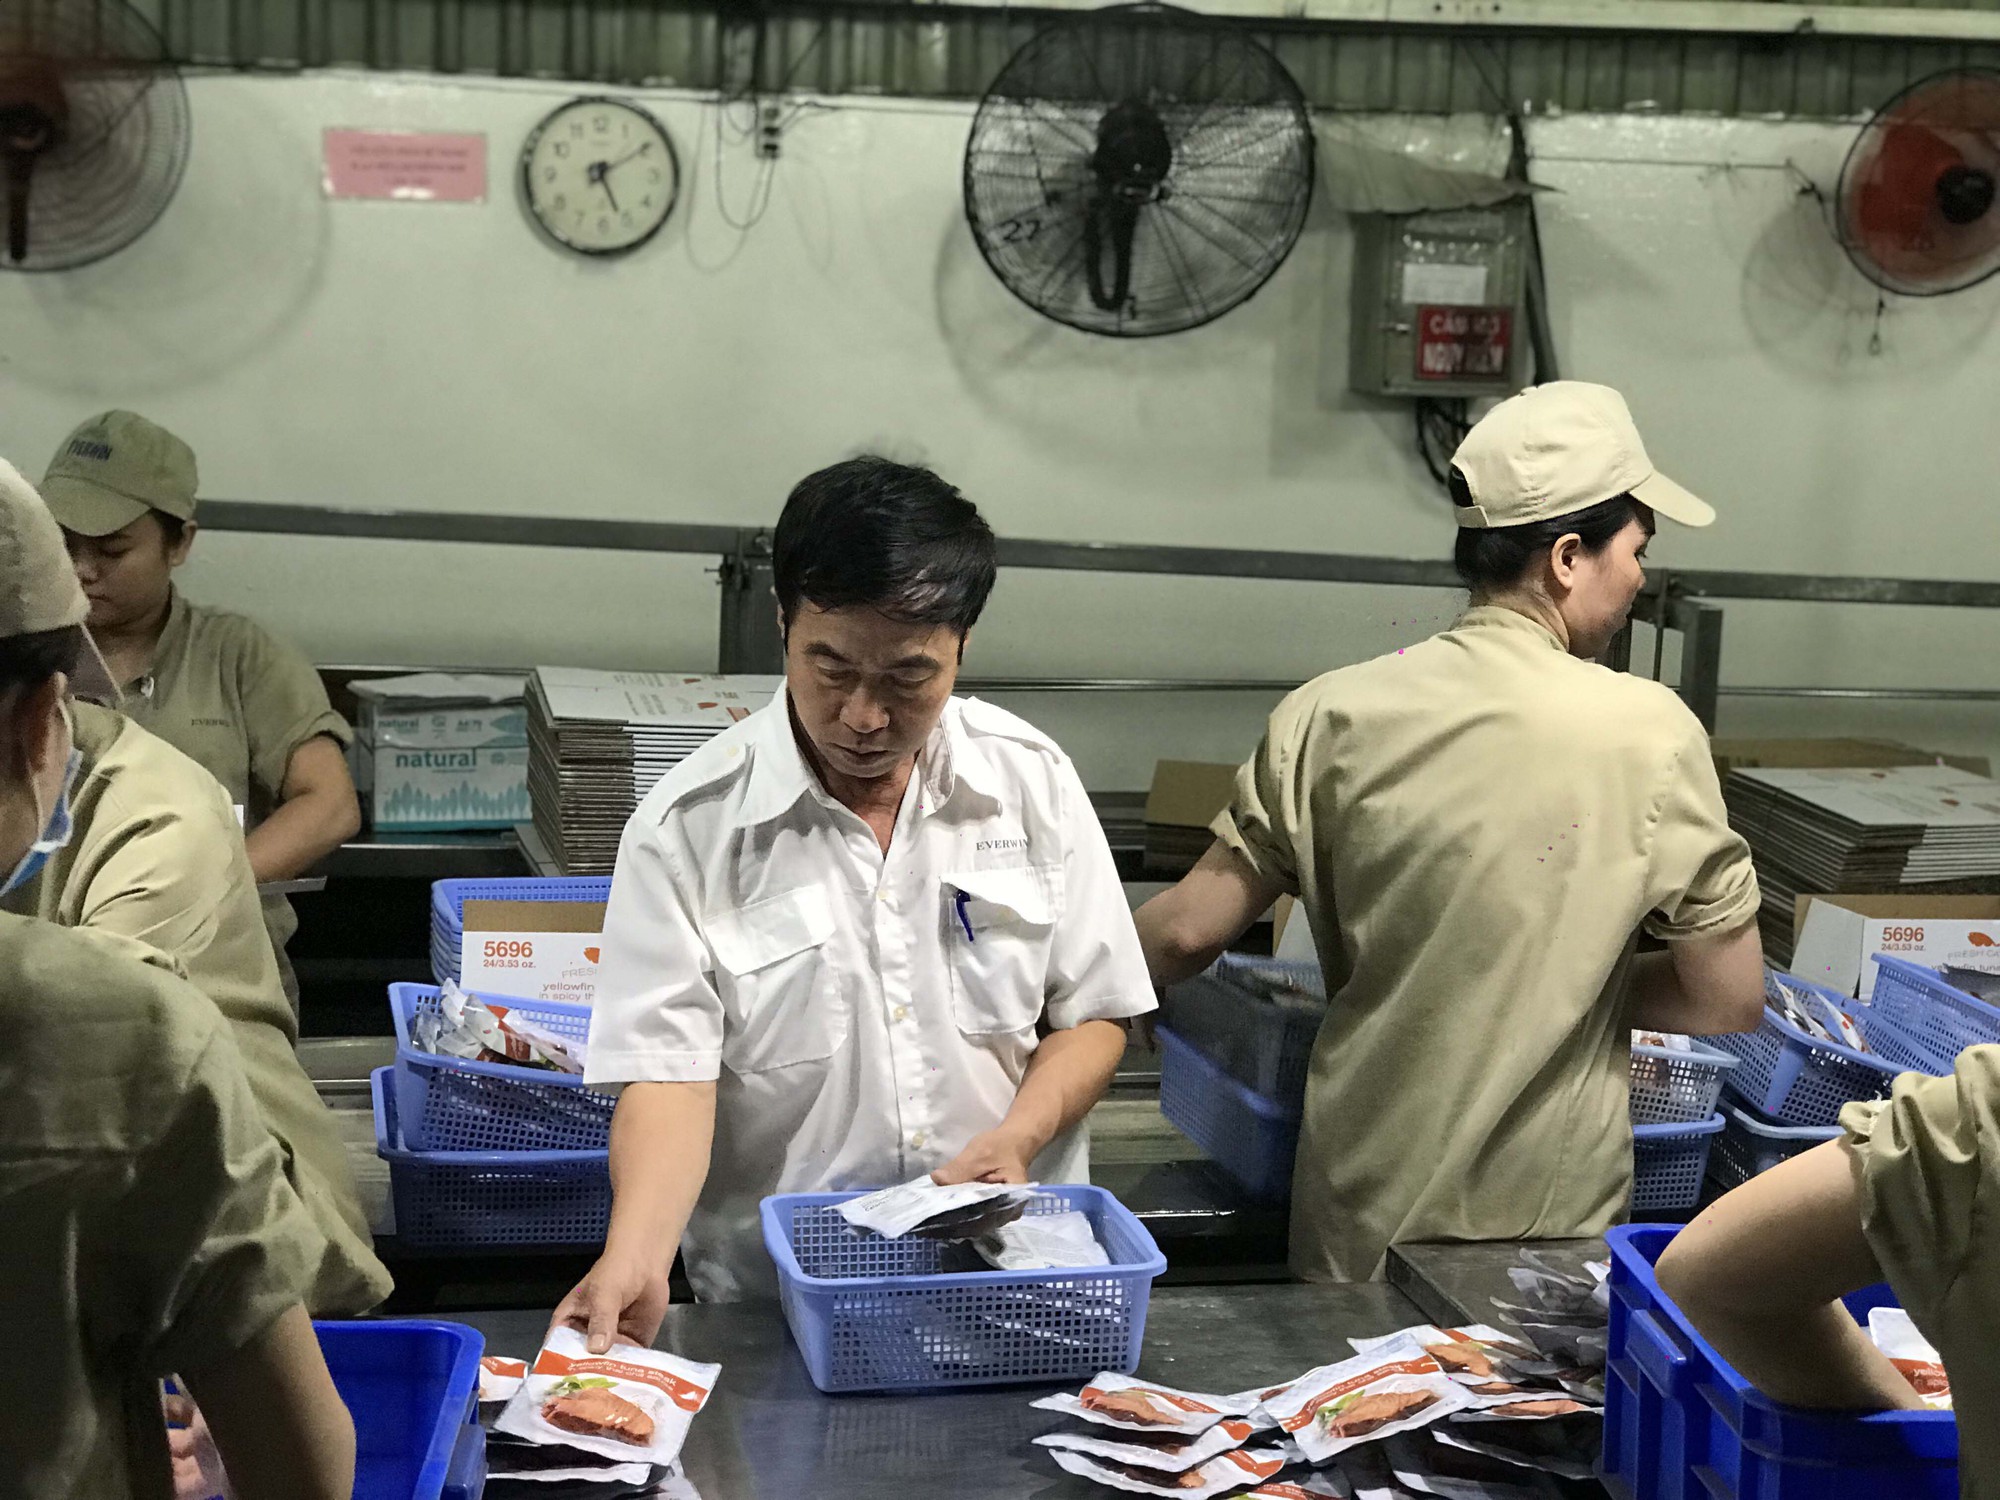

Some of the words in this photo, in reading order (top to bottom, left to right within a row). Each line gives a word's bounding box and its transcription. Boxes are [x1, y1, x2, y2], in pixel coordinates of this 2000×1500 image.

[570, 123, 584, 139] 11
[593, 115, 610, 133] 12
[554, 141, 570, 159] 10
[544, 166, 556, 184] 9
[648, 168, 660, 184] 3
[553, 194, 566, 211] 8
[597, 217, 609, 234] 6
[396, 748, 477, 767] natural
[1882, 926, 1925, 942] 5696
[483, 941, 533, 958] 5696
[1881, 943, 1912, 951] 24/3.53
[1947, 950, 1984, 960] FRESH
[483, 959, 519, 968] 24/3.53
[521, 961, 536, 969] oz.
[542, 982, 595, 992] yellowfin
[553, 992, 581, 1002] spicy
